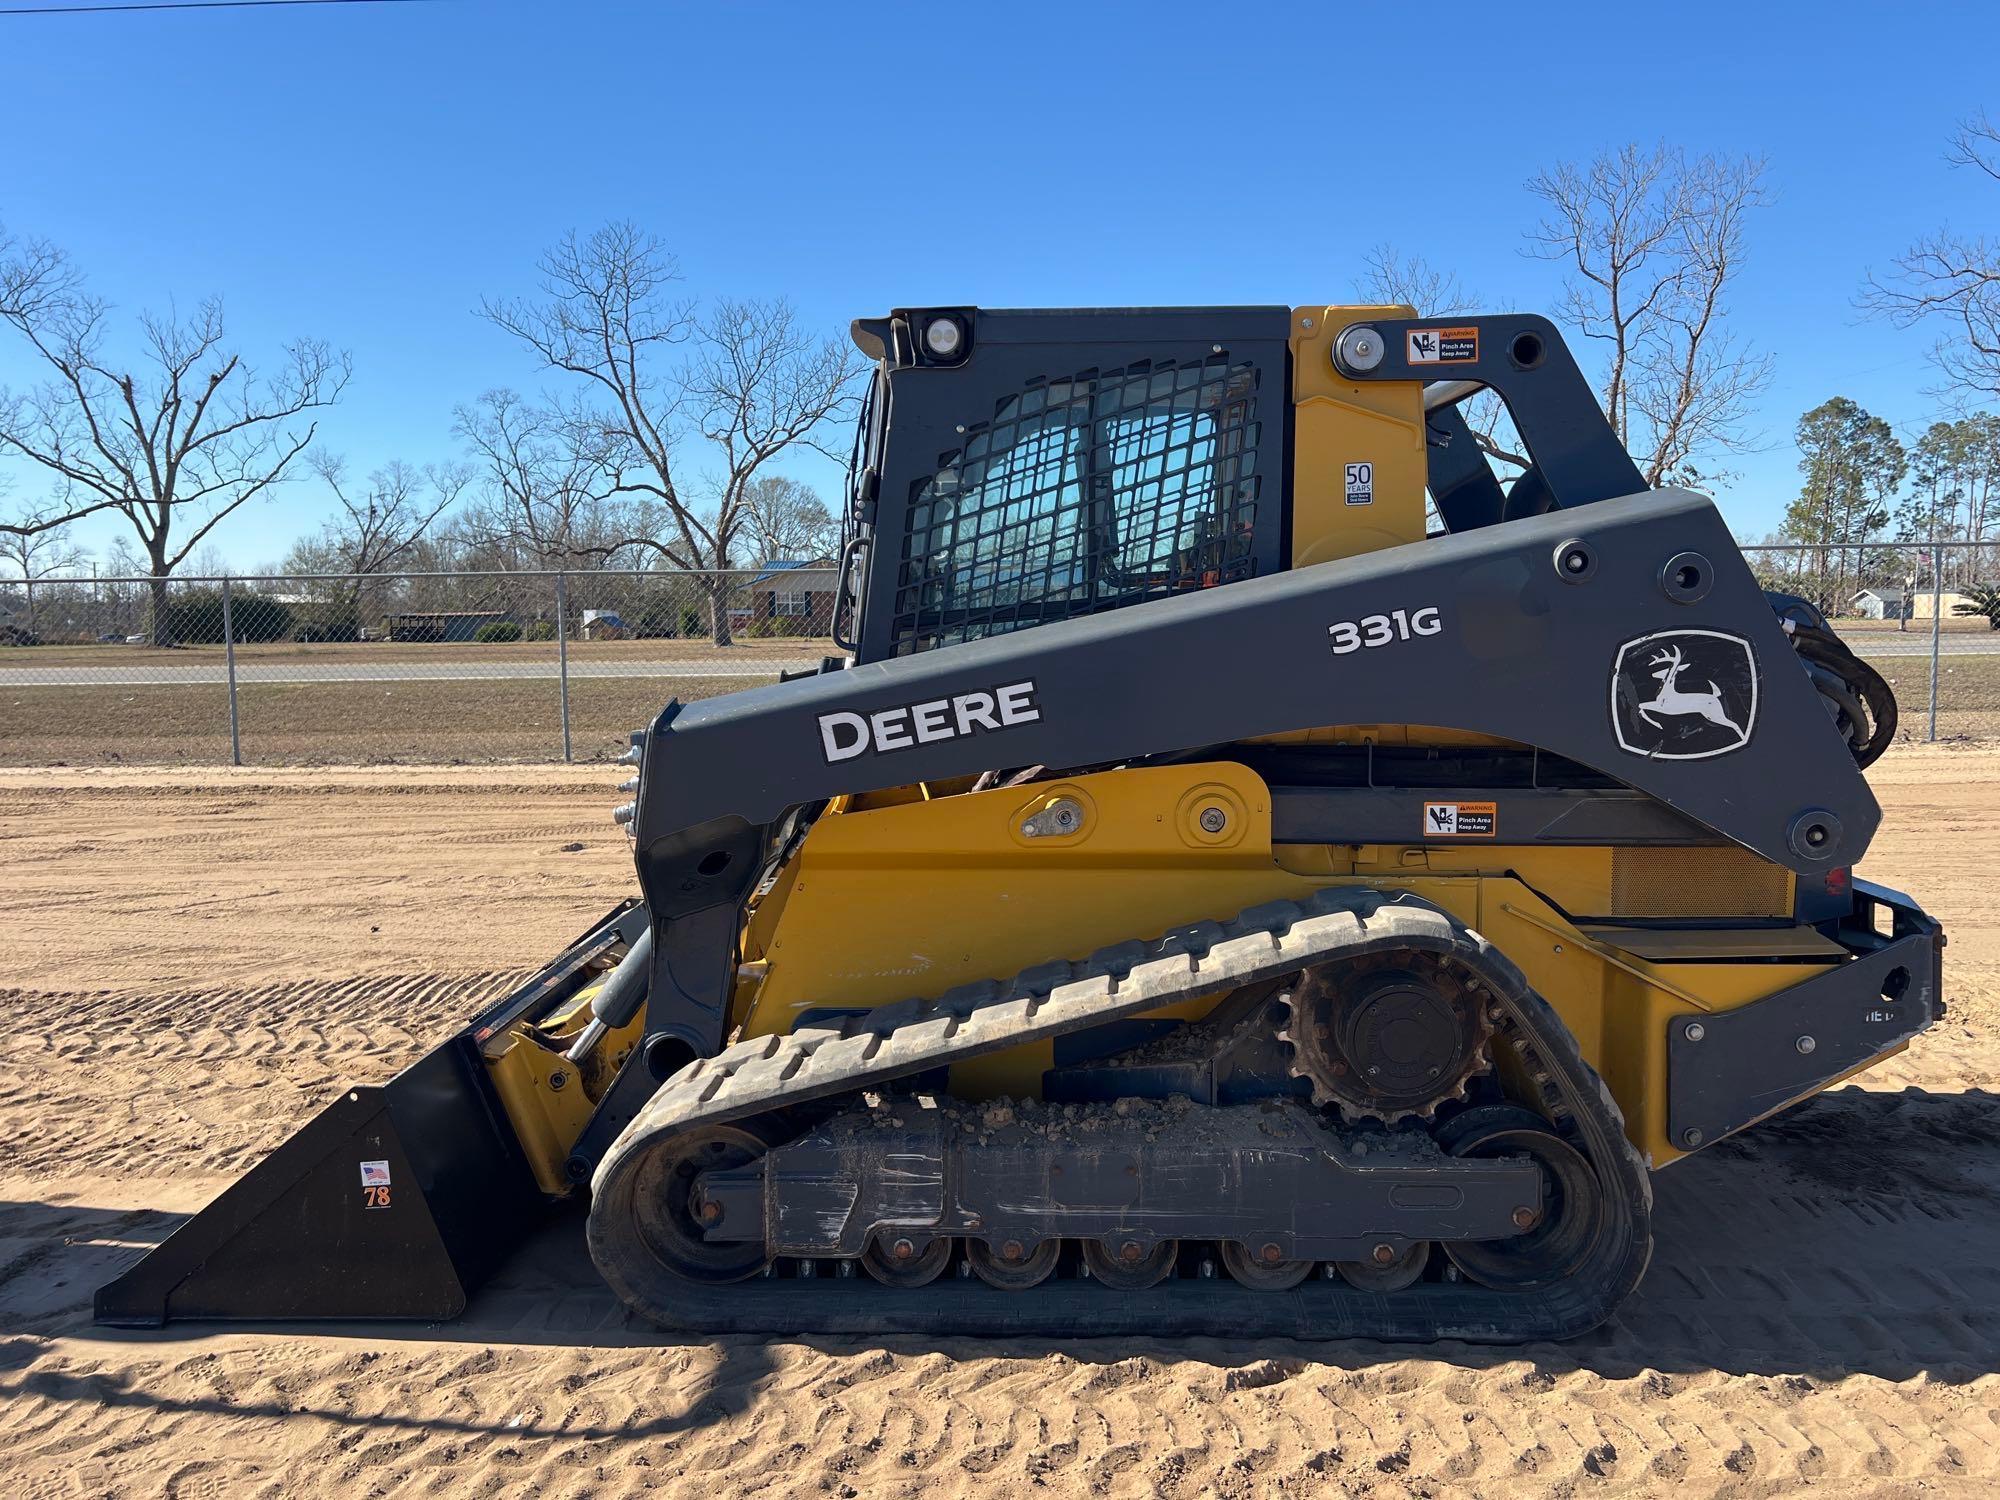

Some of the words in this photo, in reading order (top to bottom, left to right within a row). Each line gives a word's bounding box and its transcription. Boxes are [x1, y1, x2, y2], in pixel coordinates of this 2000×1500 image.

[1347, 465, 1371, 485] 50
[1328, 607, 1442, 654] 331G
[818, 681, 1040, 763] DEERE
[364, 1186, 391, 1206] 78
